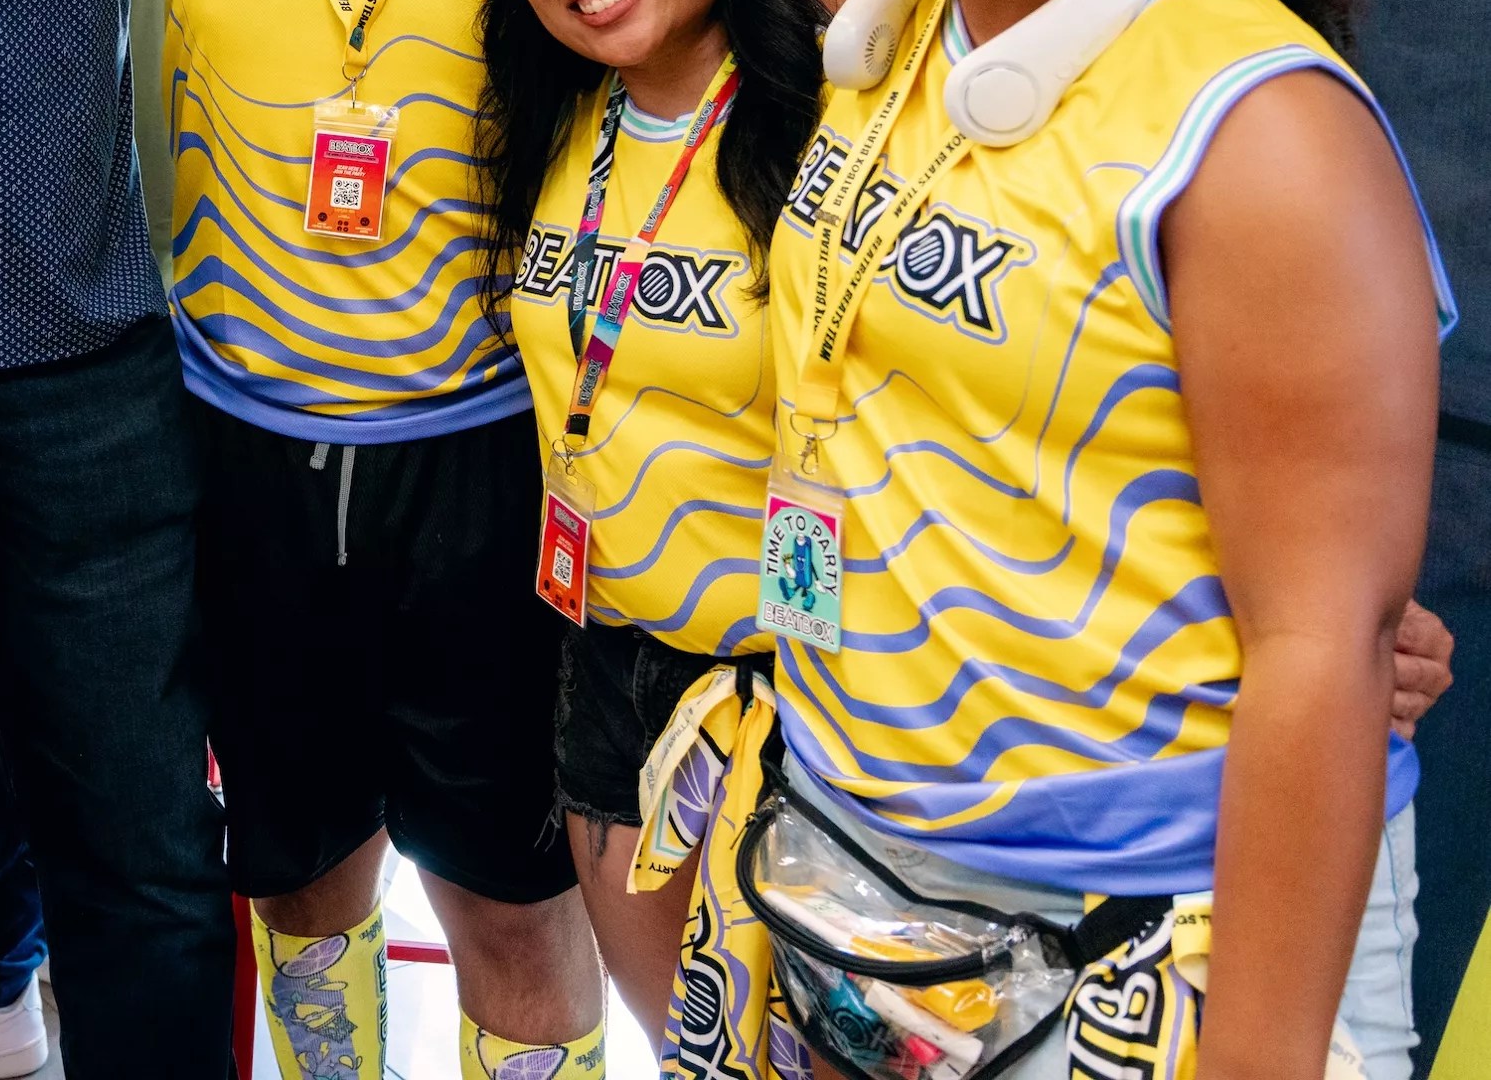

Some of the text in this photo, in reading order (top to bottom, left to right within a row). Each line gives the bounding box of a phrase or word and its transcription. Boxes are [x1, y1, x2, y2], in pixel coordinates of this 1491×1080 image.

[684, 98, 718, 148] BEATBOX
[328, 139, 376, 156] BEATBOX
[833, 91, 900, 207] BEATBOX BEATS TEAM
[642, 185, 673, 233] BEATBOX
[819, 227, 831, 261] TEAM
[572, 261, 589, 312] BEATBOX
[605, 271, 633, 324] BEATBOX
[816, 264, 828, 307] BEATS
[819, 327, 837, 363] TEAM
[766, 514, 838, 598] TIME TO PARTY
[763, 601, 836, 646] BEATBOX
